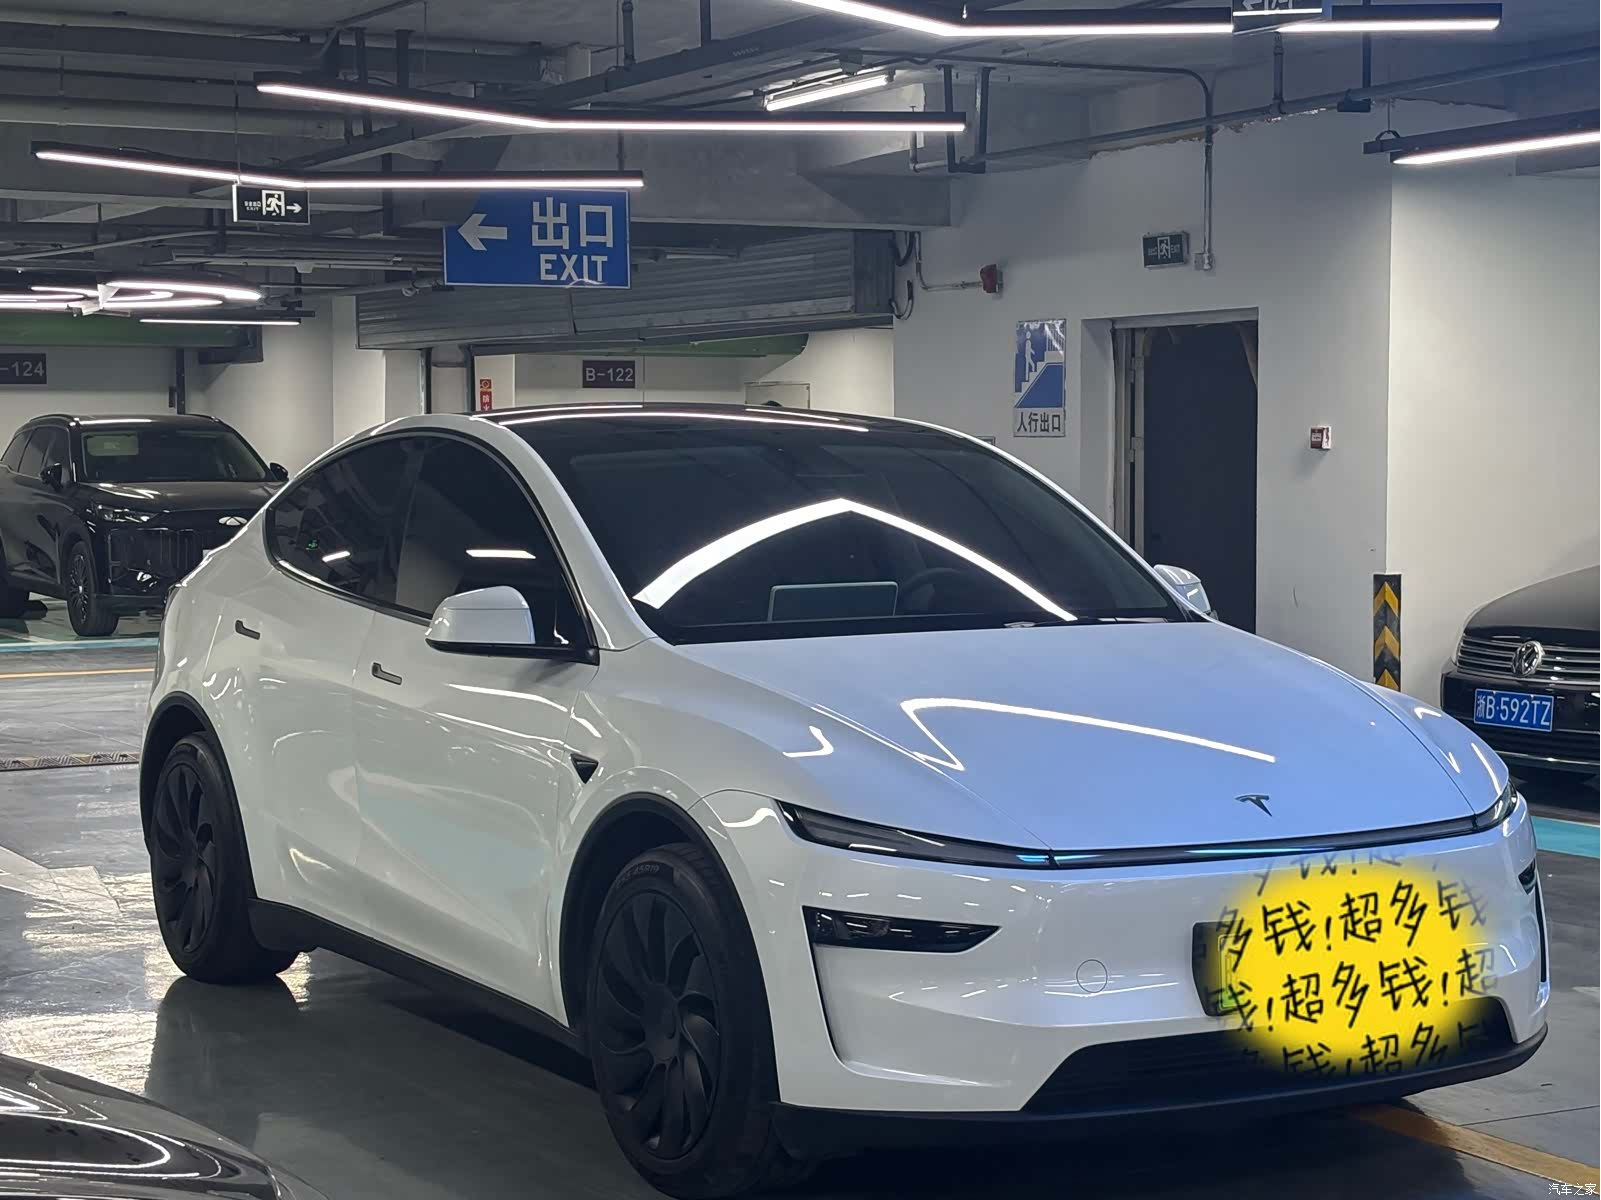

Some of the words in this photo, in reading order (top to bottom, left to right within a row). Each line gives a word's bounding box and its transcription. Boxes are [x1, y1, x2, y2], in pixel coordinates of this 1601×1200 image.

[531, 196, 614, 250] 出口
[539, 253, 609, 281] EXIT
[585, 367, 634, 382] B-122
[1016, 411, 1062, 433] 人行出口
